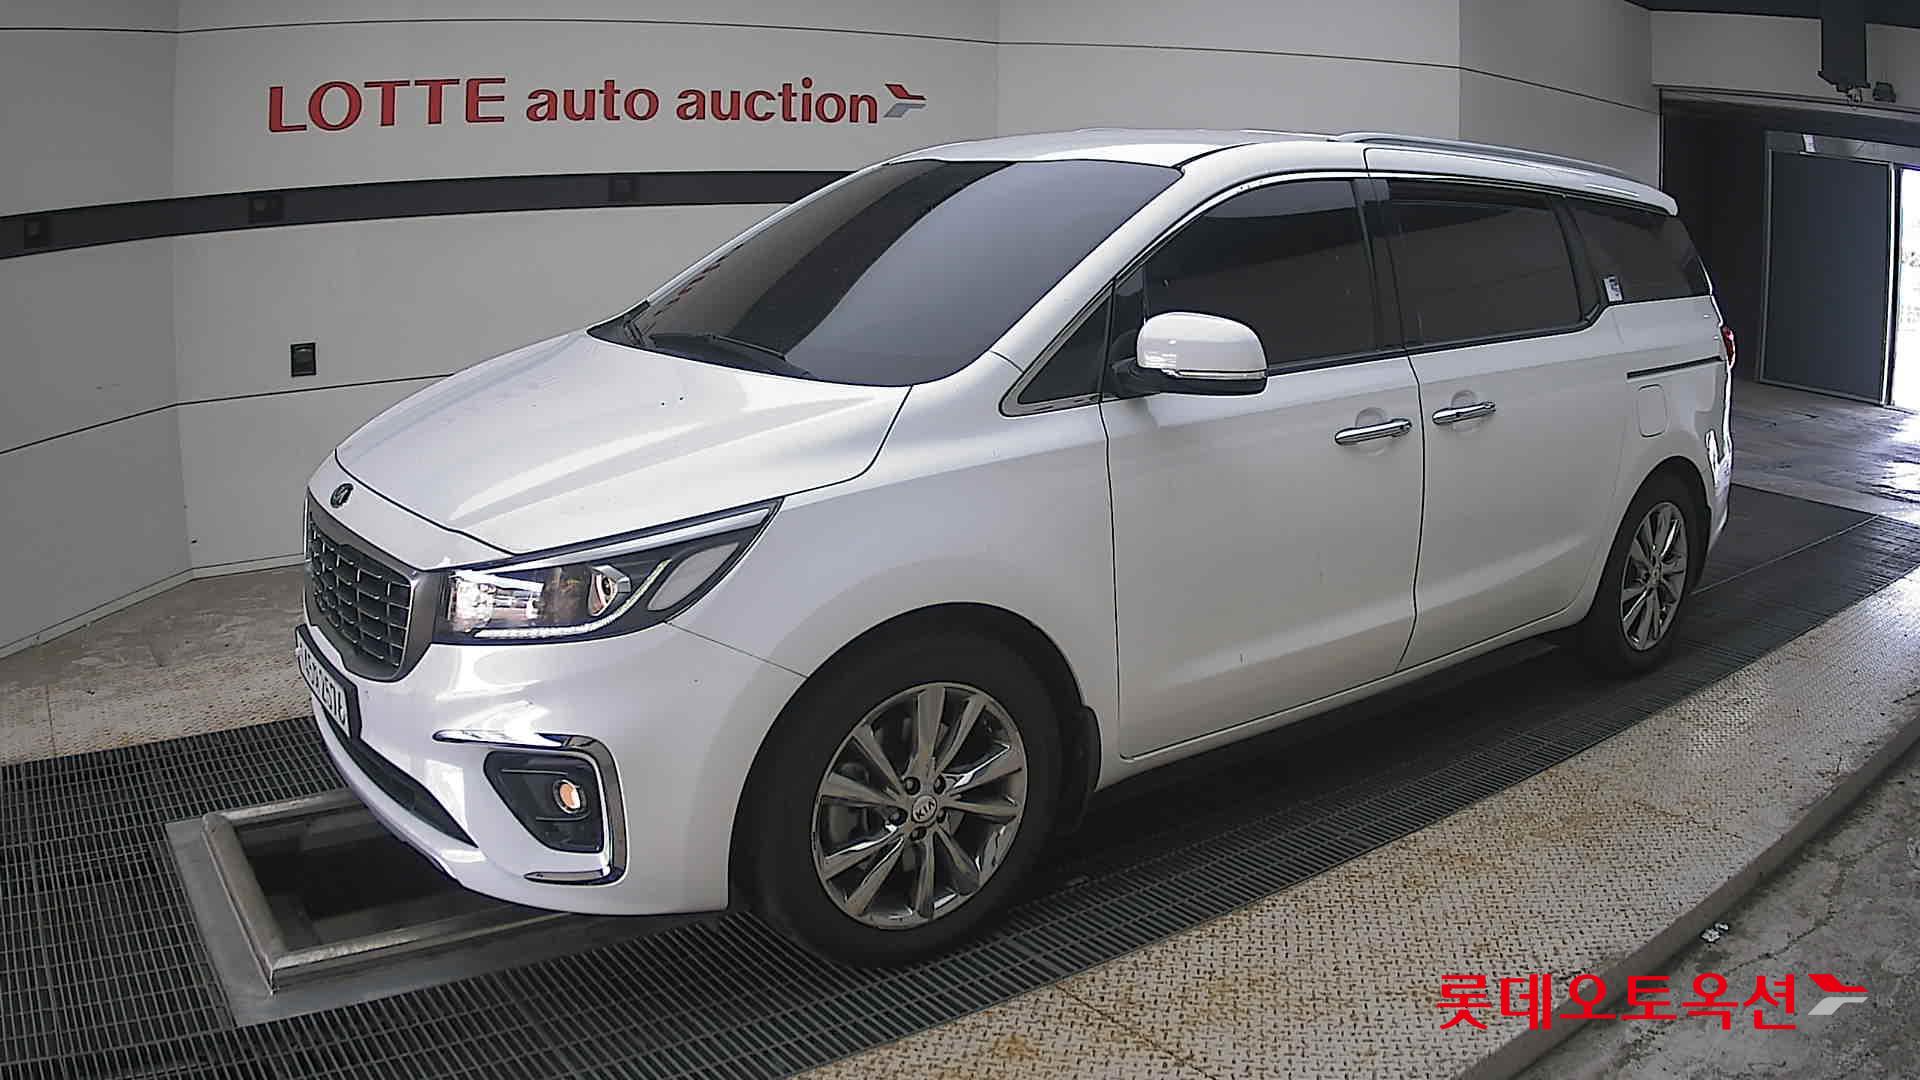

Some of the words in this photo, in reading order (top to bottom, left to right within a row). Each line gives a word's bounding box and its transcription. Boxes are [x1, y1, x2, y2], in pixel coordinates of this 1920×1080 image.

[268, 78, 505, 133] LOTTE
[526, 79, 660, 122] auto
[675, 78, 879, 124] auction
[914, 800, 935, 820] KIA
